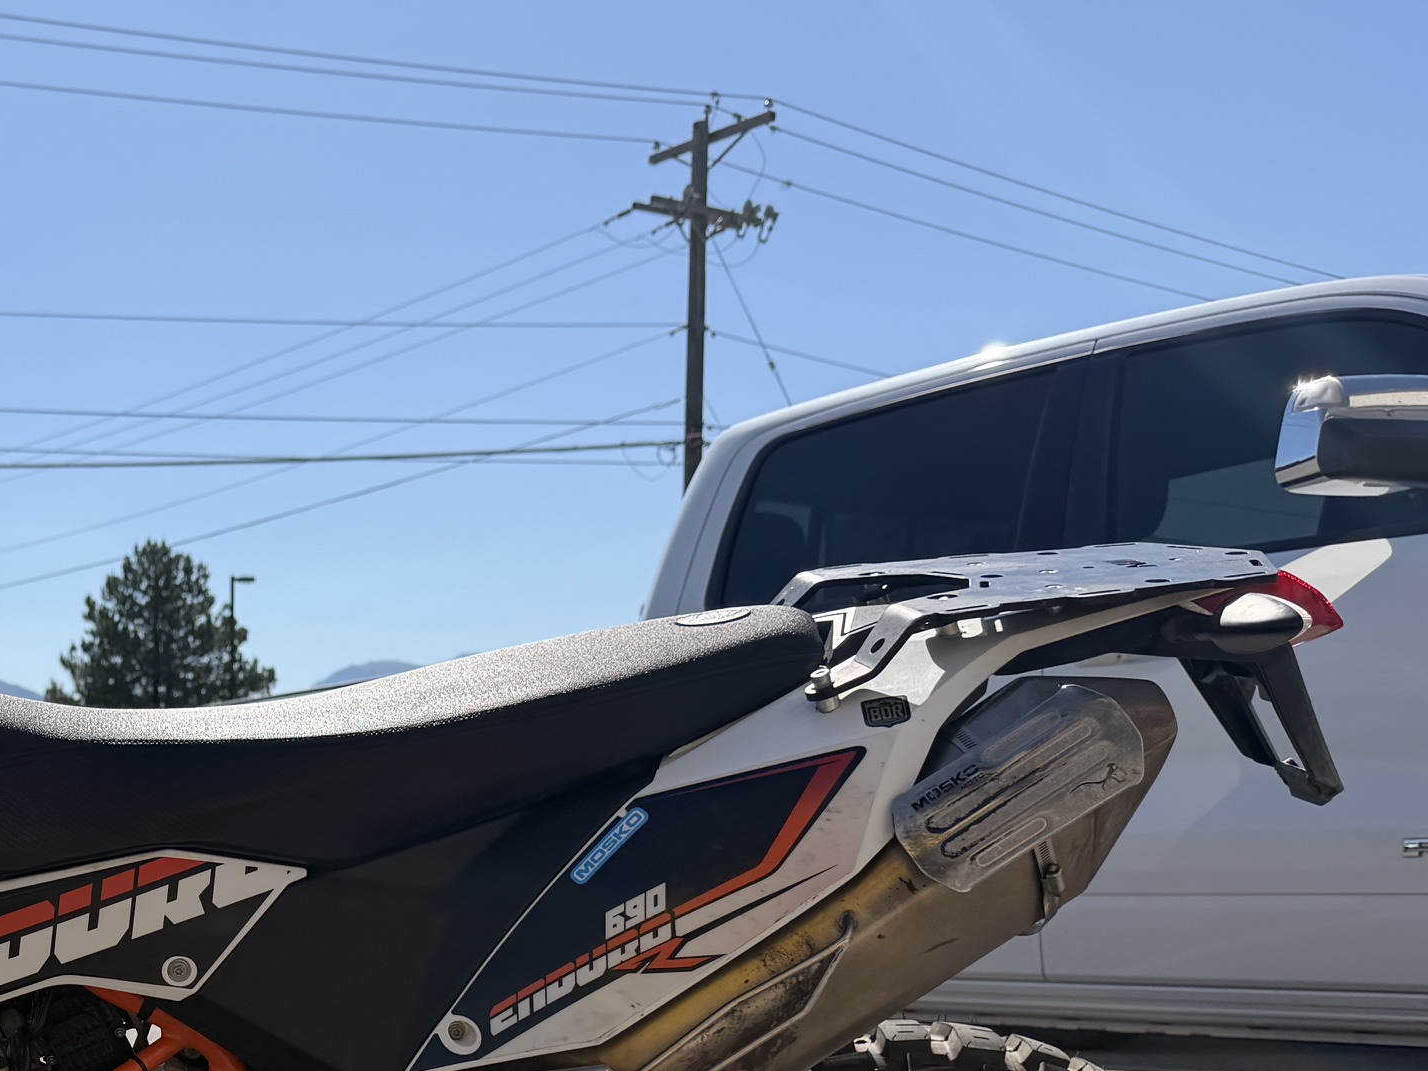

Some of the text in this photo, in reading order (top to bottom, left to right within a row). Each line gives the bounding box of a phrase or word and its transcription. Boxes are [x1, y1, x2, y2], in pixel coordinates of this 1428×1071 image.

[870, 703, 904, 721] BDR
[911, 764, 979, 812] MOSKO
[575, 811, 643, 879] MOSKO
[605, 882, 666, 940] 690
[490, 913, 672, 1037] ENDURO
